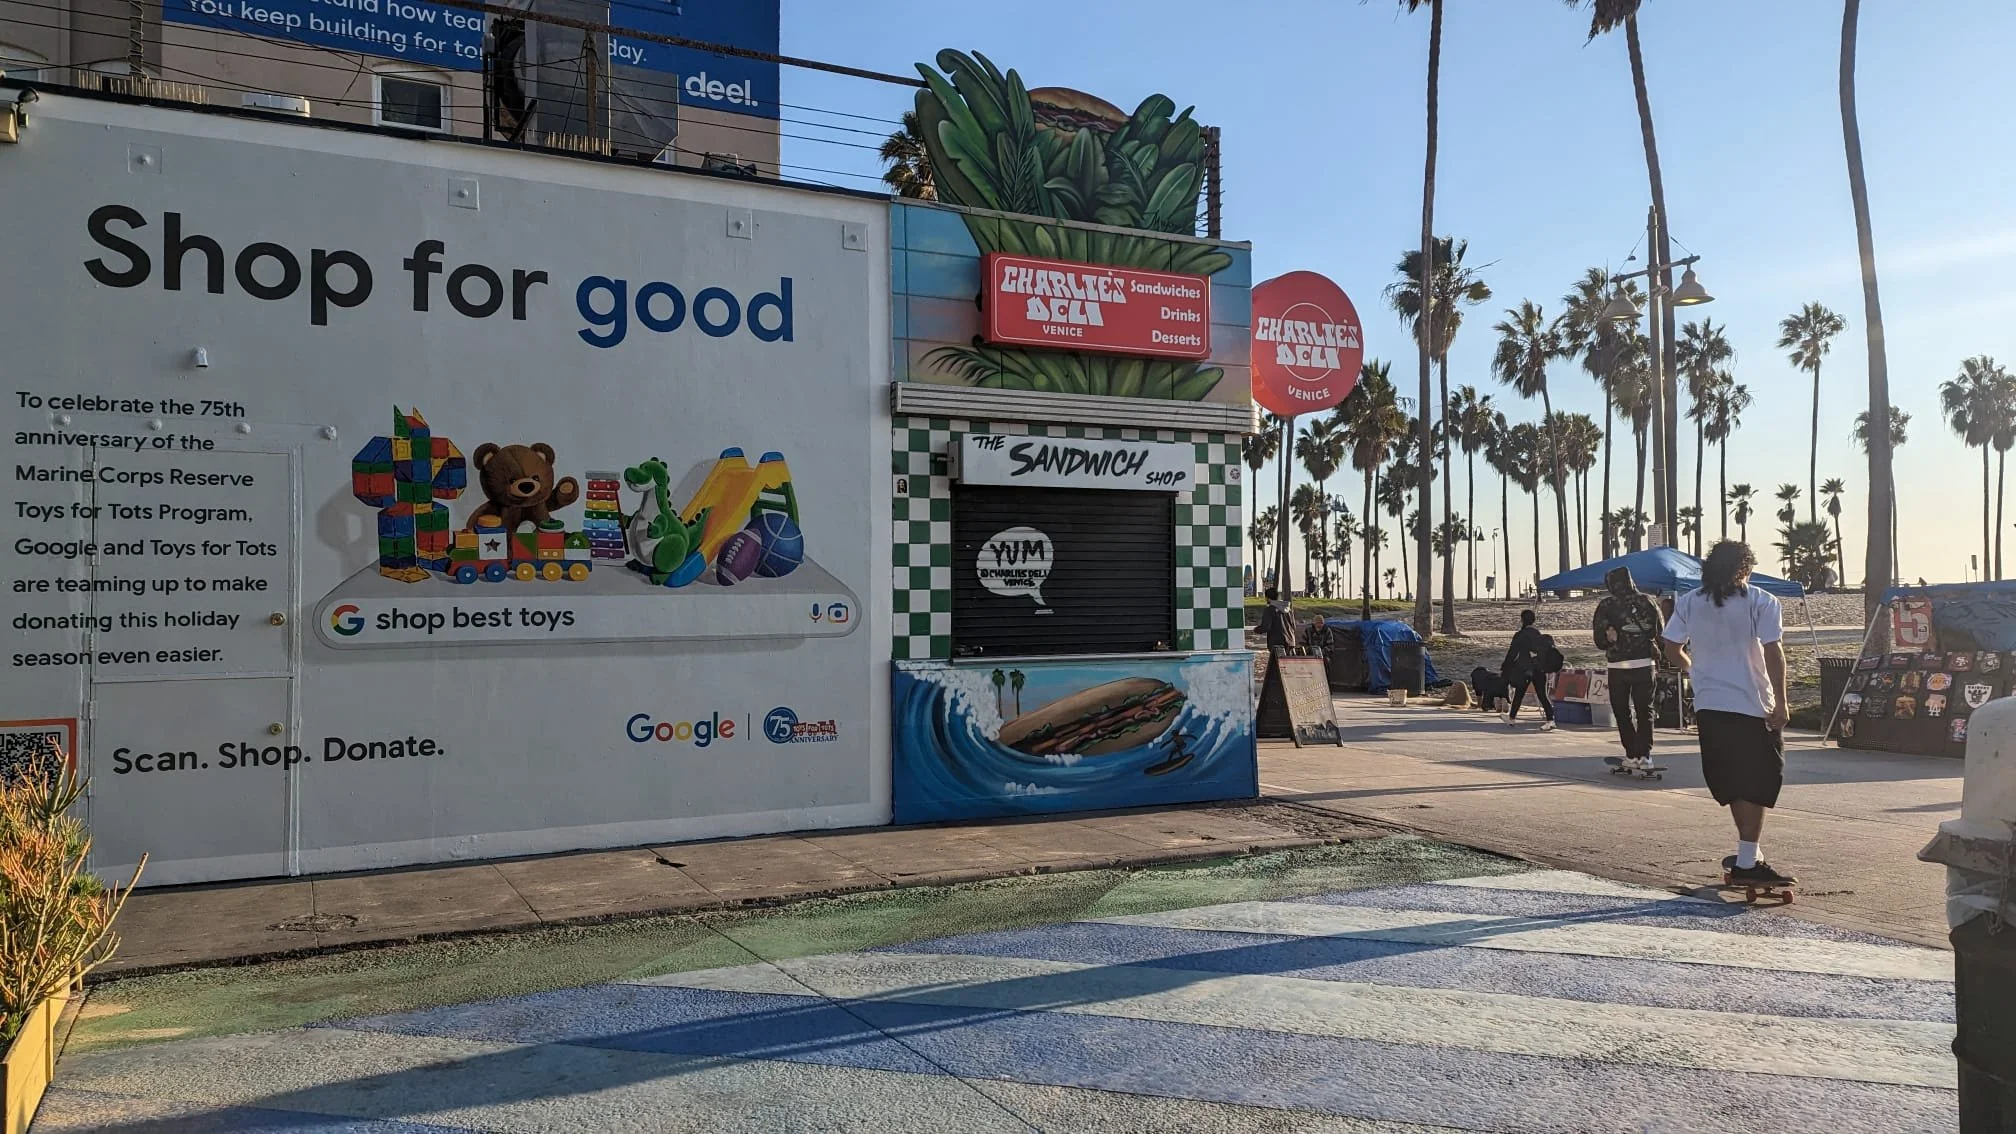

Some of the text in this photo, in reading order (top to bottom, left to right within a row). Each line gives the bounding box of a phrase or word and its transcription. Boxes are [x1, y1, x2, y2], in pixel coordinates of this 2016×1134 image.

[387, 0, 437, 24] how
[190, 0, 232, 17] You
[241, 1, 301, 32] keep
[310, 13, 406, 53] building
[413, 31, 446, 54] for
[685, 71, 758, 107] deel.
[84, 204, 794, 348] Shop for good
[1001, 266, 1127, 304] CHARLIE'S
[1130, 280, 1200, 299] Sandwiches
[1026, 296, 1104, 326] DELI
[1160, 307, 1201, 323] Drinks
[1042, 325, 1083, 338] VENICE
[1152, 329, 1201, 347] Desserts
[1255, 317, 1359, 349] CHARLIE'S
[1276, 344, 1341, 370] DELI
[1288, 386, 1330, 400] VENICE
[16, 392, 245, 417] To celebrate the 75th
[15, 431, 214, 452] anniversary of the
[972, 435, 1005, 450] THE
[1010, 442, 1149, 476] SANDWICH
[15, 465, 254, 487] Marine Corps Reserve
[1145, 471, 1186, 486] SHOP
[15, 502, 253, 524] Toys for Tots Program,
[14, 538, 277, 559] Google and Toys for Tots
[990, 540, 1044, 567] YUM
[13, 576, 268, 595] are teaming up to make
[1003, 578, 1035, 587] VENICE
[12, 611, 239, 632] donating this holiday
[331, 604, 575, 636] G shop best toys
[12, 647, 223, 667] season even easier.
[626, 711, 735, 747] Google
[789, 735, 838, 744] ANNIVERSARY
[113, 736, 444, 775] Scan. Shop. Donate.
